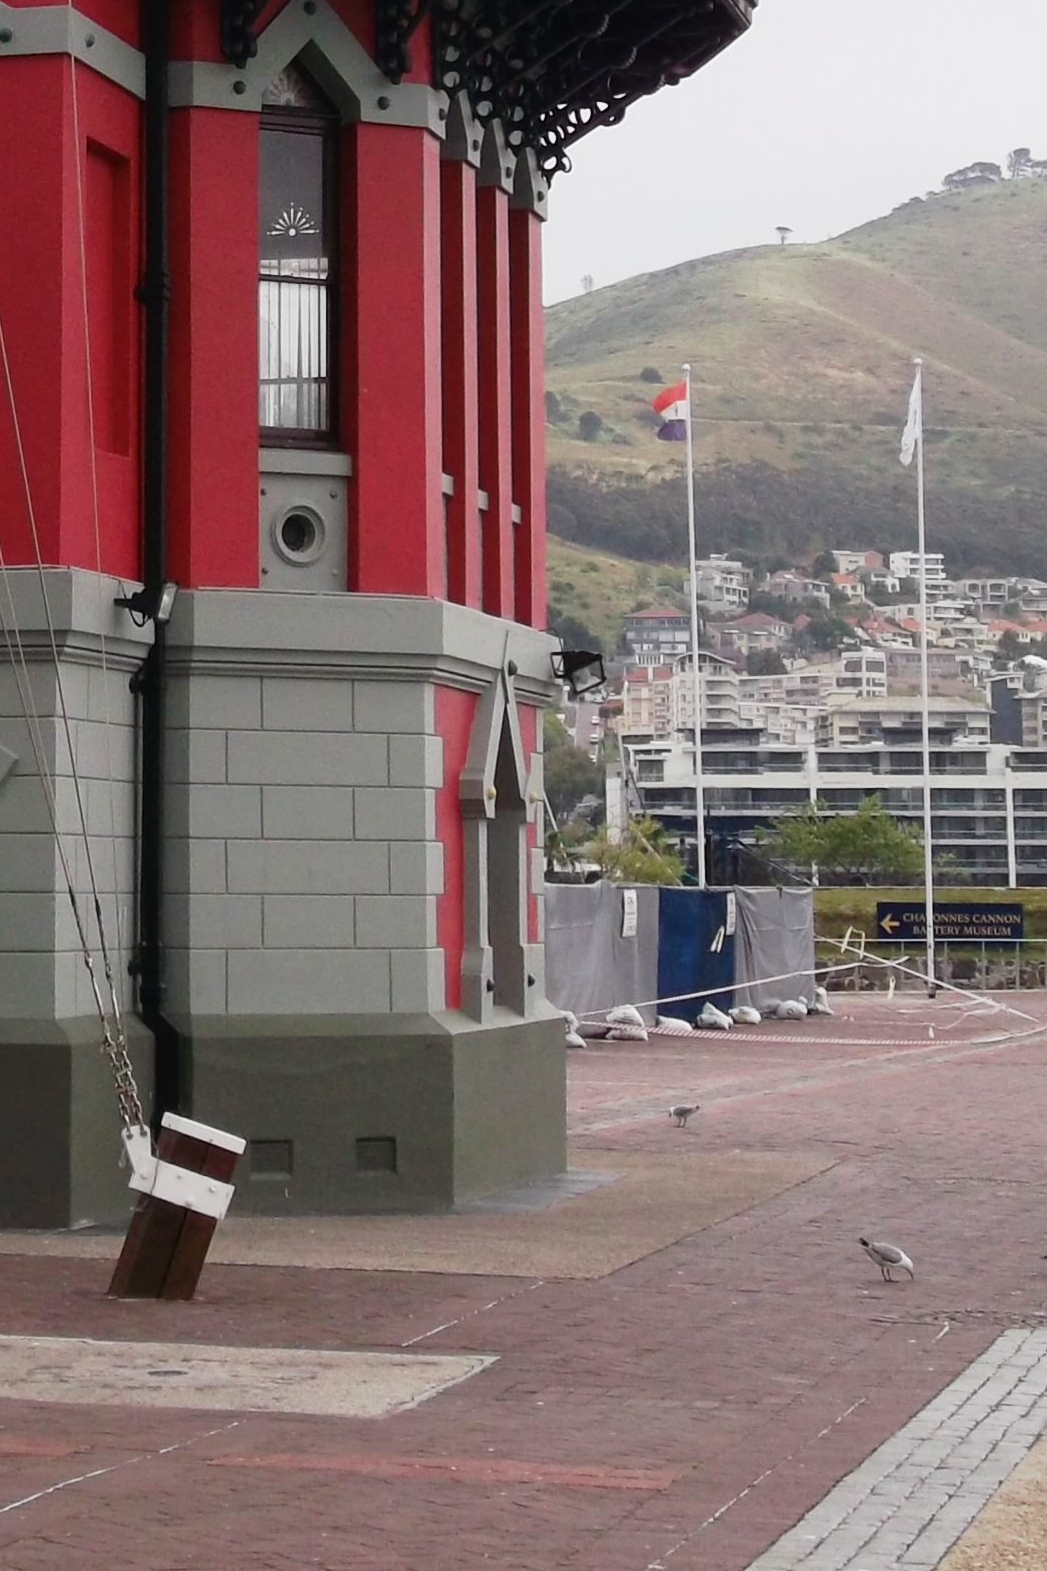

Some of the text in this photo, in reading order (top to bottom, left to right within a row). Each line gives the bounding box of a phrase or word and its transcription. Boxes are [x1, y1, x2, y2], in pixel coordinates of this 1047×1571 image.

[903, 913, 1021, 924] CHAONNES CANNON
[913, 925, 1011, 936] BATERY MUSEUM
